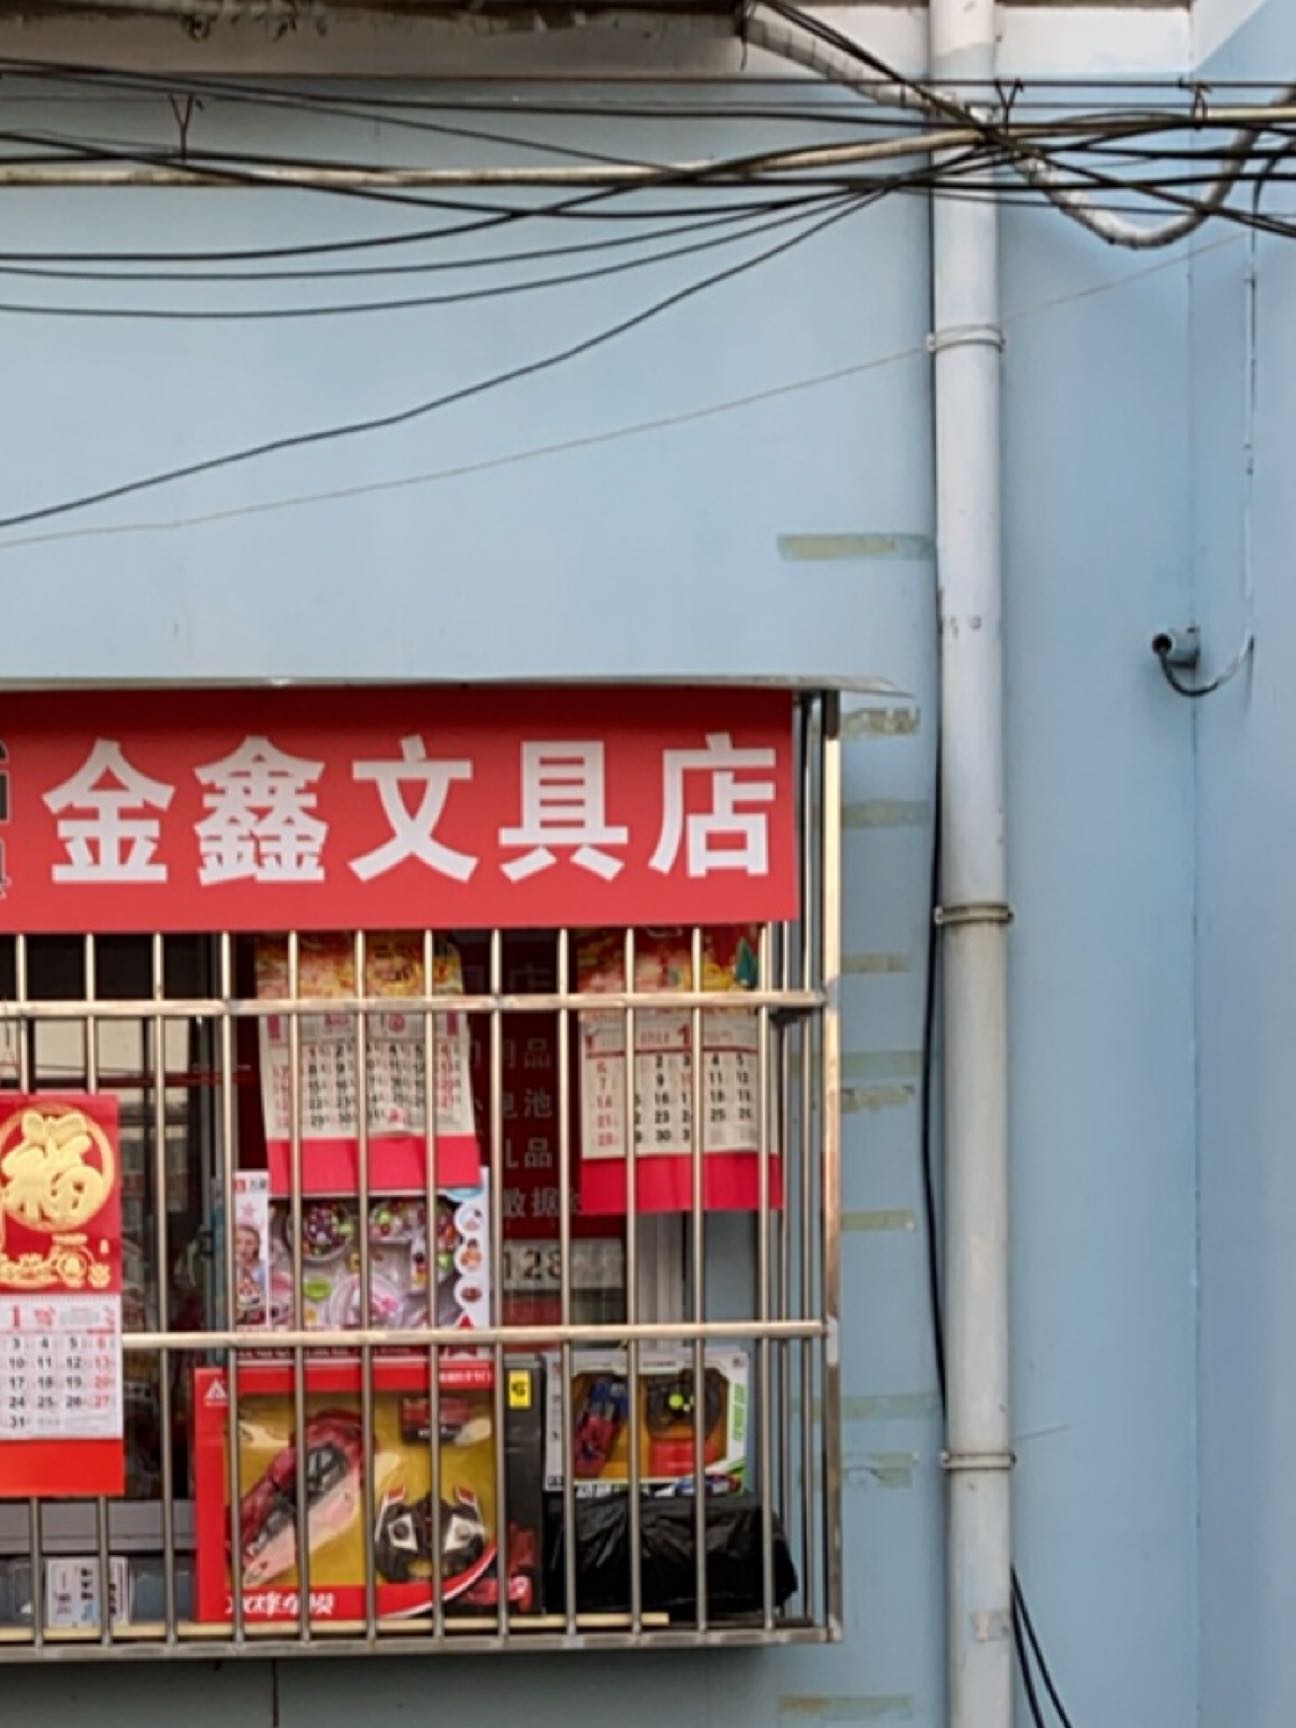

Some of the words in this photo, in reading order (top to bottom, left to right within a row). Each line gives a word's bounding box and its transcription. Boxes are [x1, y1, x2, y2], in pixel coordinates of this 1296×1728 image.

[41, 731, 777, 885] 金鑫文具店
[0, 1108, 106, 1223] 福
[8, 1375, 24, 1390] 17
[37, 1375, 53, 1390] 18
[65, 1374, 82, 1389] 19
[8, 1395, 25, 1410] 24
[37, 1394, 53, 1409] 25
[65, 1394, 82, 1409] 26
[9, 1414, 26, 1429] 31
